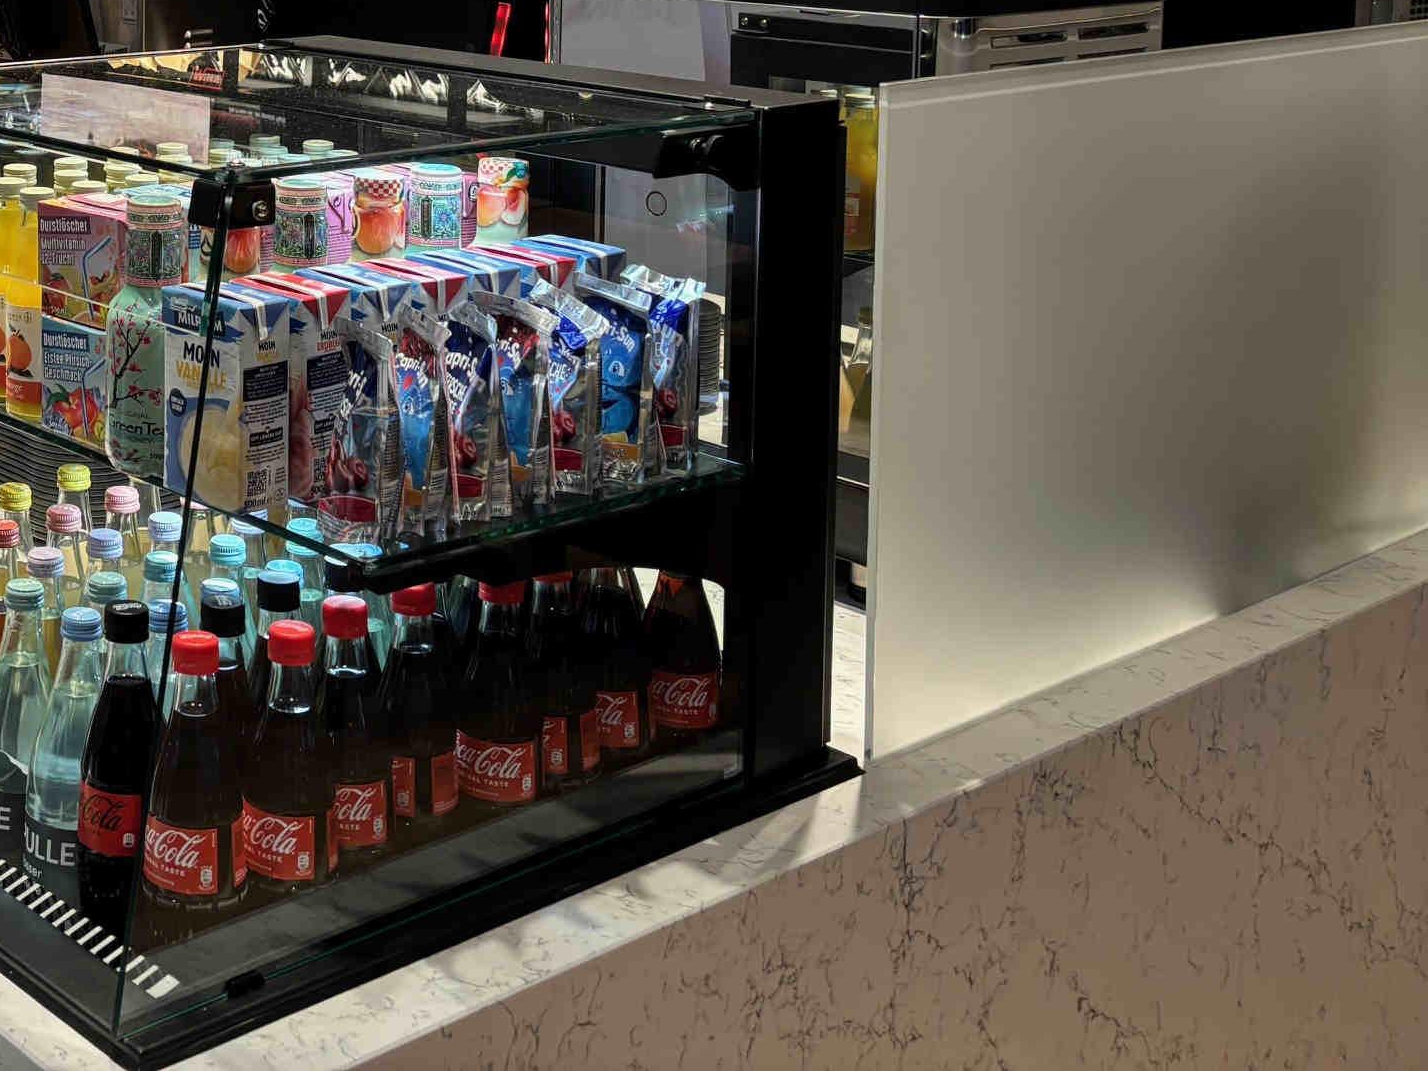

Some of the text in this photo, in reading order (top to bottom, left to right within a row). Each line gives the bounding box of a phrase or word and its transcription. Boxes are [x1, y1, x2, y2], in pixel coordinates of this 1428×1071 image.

[40, 217, 88, 233] Durstlöscher
[178, 310, 223, 332] MILRM
[43, 332, 87, 350] Durstlöscher
[183, 341, 220, 369] MON
